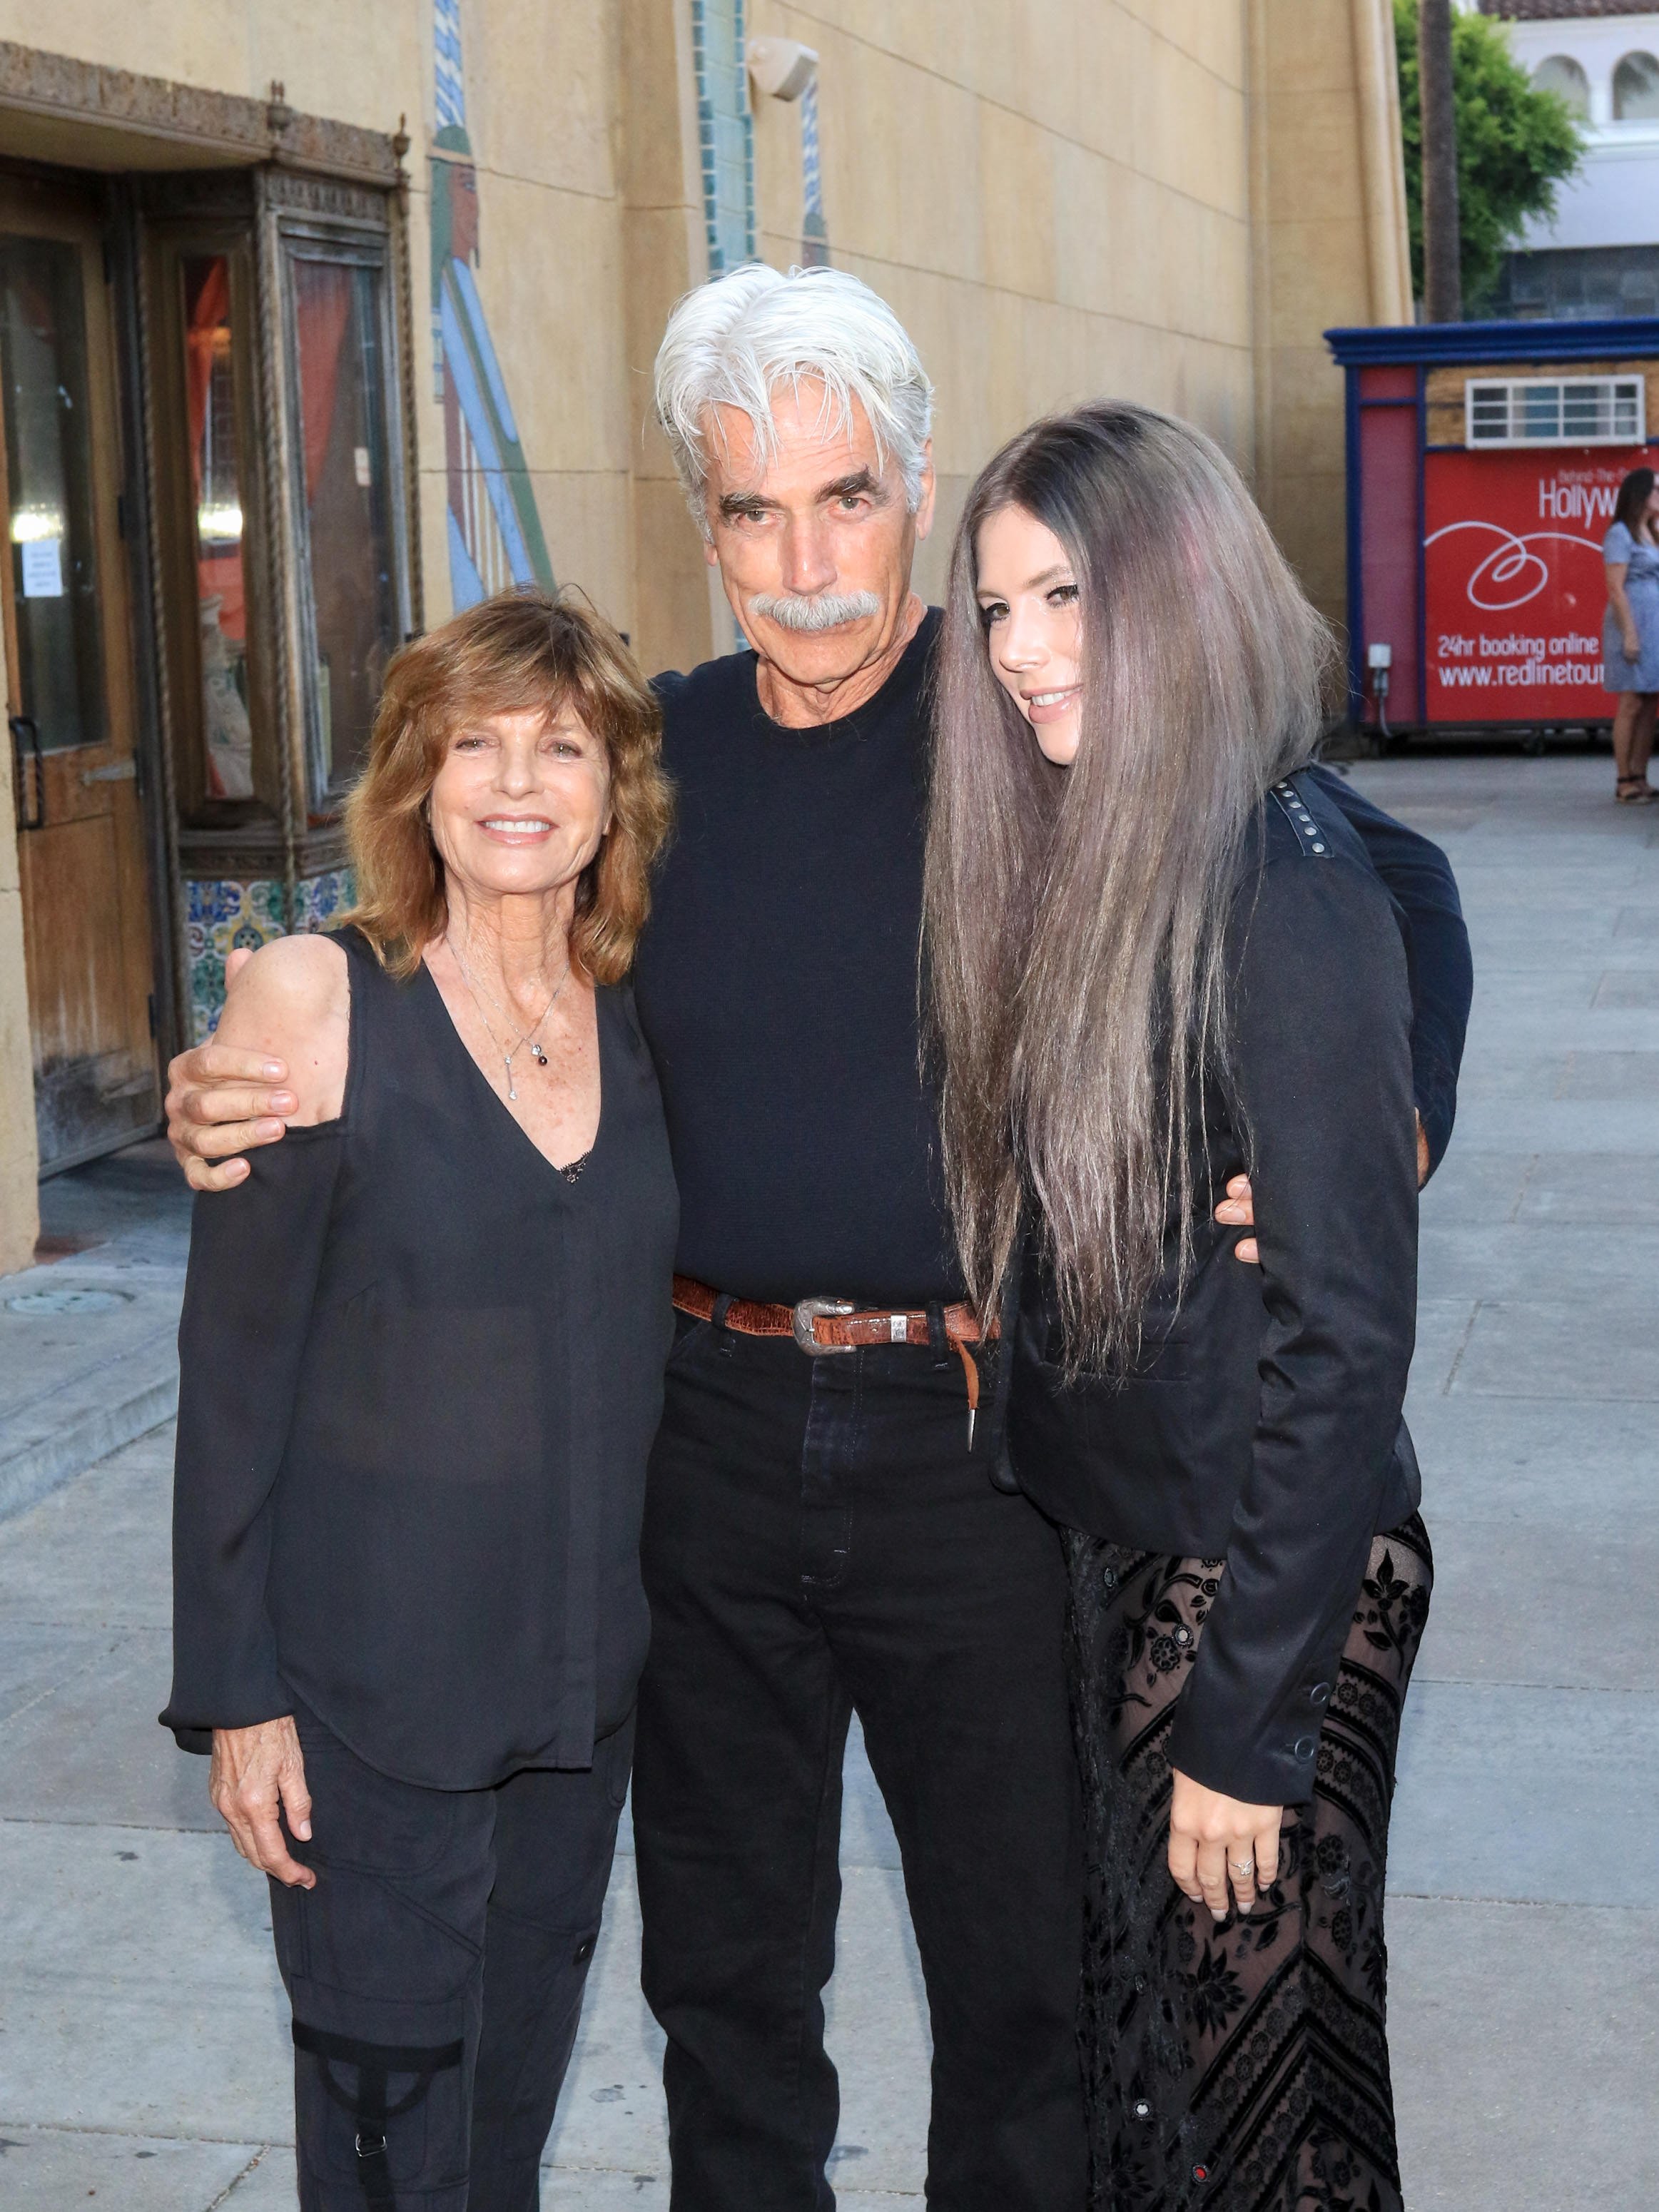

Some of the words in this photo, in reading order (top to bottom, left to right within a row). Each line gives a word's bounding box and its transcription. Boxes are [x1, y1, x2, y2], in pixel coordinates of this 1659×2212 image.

[1438, 634, 1475, 657] 24hr
[1479, 633, 1545, 662] booking
[1548, 632, 1599, 654] online
